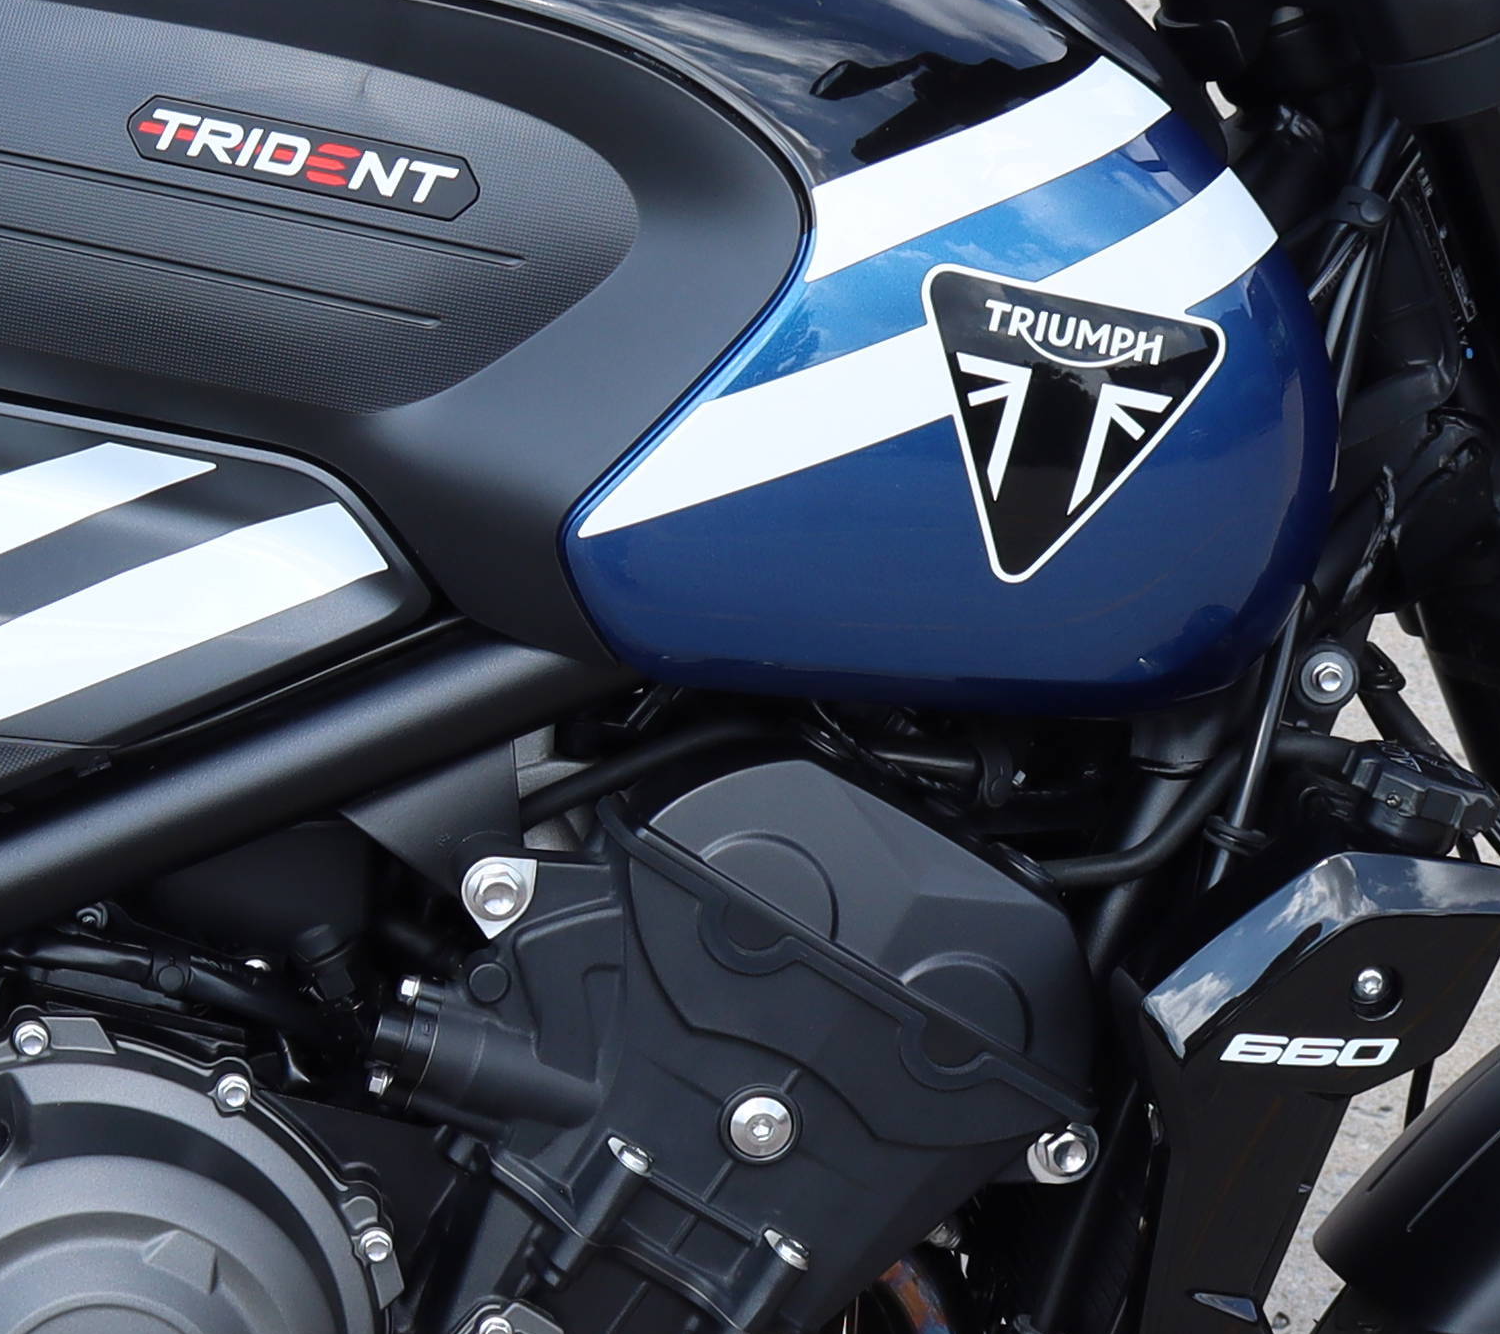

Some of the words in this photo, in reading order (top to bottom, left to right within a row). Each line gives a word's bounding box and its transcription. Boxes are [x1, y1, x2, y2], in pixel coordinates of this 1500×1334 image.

[139, 109, 460, 203] TRIDENT
[985, 299, 1164, 368] TRIUMPH
[1220, 1033, 1400, 1067] 660
